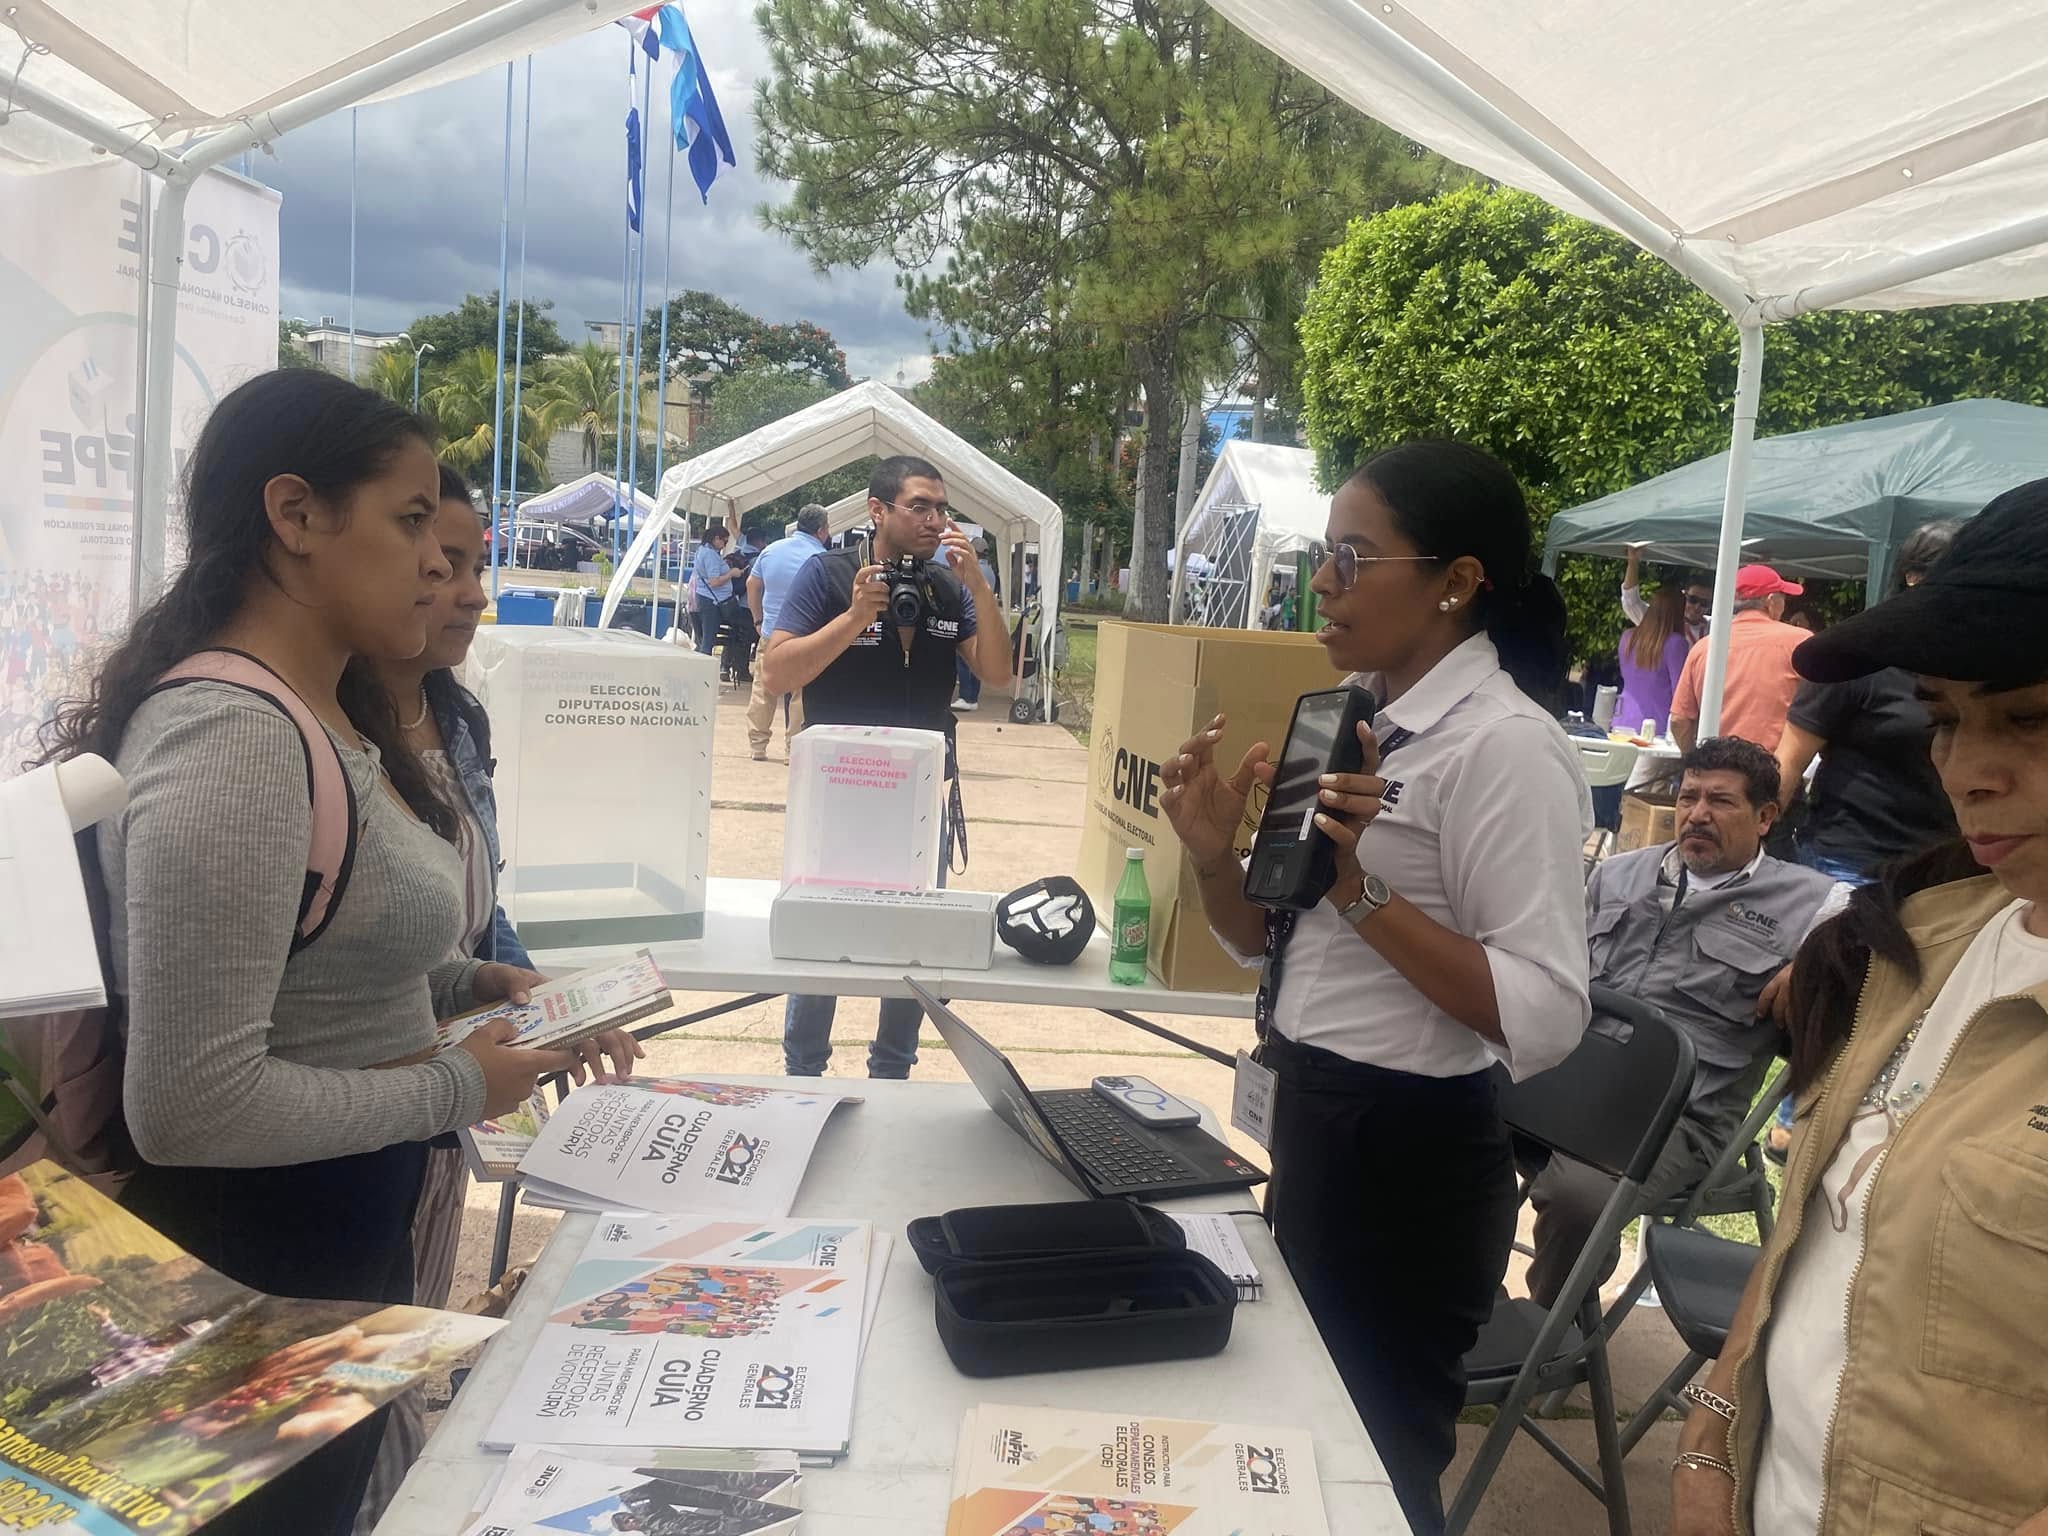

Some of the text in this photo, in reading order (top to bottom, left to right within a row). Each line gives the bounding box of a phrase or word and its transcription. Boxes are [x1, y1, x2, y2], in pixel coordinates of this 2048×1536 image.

[937, 619, 959, 632] CNE
[558, 699, 690, 713] DIPUTADOS(AS) AL
[589, 683, 662, 697] ELECCIÓN
[544, 714, 700, 727] CONGRESO NACIONAL
[820, 764, 908, 780] CORPORACIONES
[828, 775, 898, 790] MUNICIPALES
[1112, 746, 1162, 820] CNE
[1744, 909, 1779, 930] CNE
[641, 1113, 687, 1161] GUÍA
[661, 1110, 714, 1185] CUADERNO
[704, 1128, 736, 1178] GENERALES
[715, 1131, 760, 1185] 2021
[741, 1139, 771, 1187] ELECCIONES
[819, 1244, 838, 1267] CNE
[626, 1347, 642, 1367] PARA
[558, 1345, 607, 1418] RECEPTORAS
[588, 1360, 622, 1402] JUNTAS
[649, 1358, 692, 1408] GUÍA
[683, 1348, 721, 1421] CUADERNO
[738, 1363, 760, 1409] GENERALES
[754, 1364, 795, 1409] 2021
[790, 1365, 808, 1409] ELECCIONES
[1007, 1430, 1023, 1466] INFPE
[1100, 1443, 1114, 1469] (CDE)
[1115, 1425, 1128, 1489] ELECTORALES
[1130, 1421, 1142, 1495] DEPARTAMENTALES
[1142, 1434, 1156, 1486] CONSEJOS
[1234, 1442, 1249, 1492] GENERALES
[1246, 1444, 1281, 1494] 2021
[50, 1455, 173, 1528] Productivo
[534, 1464, 558, 1487] CNE
[1163, 1471, 1171, 1488] PARA
[1274, 1447, 1290, 1496] ELECCIONES
